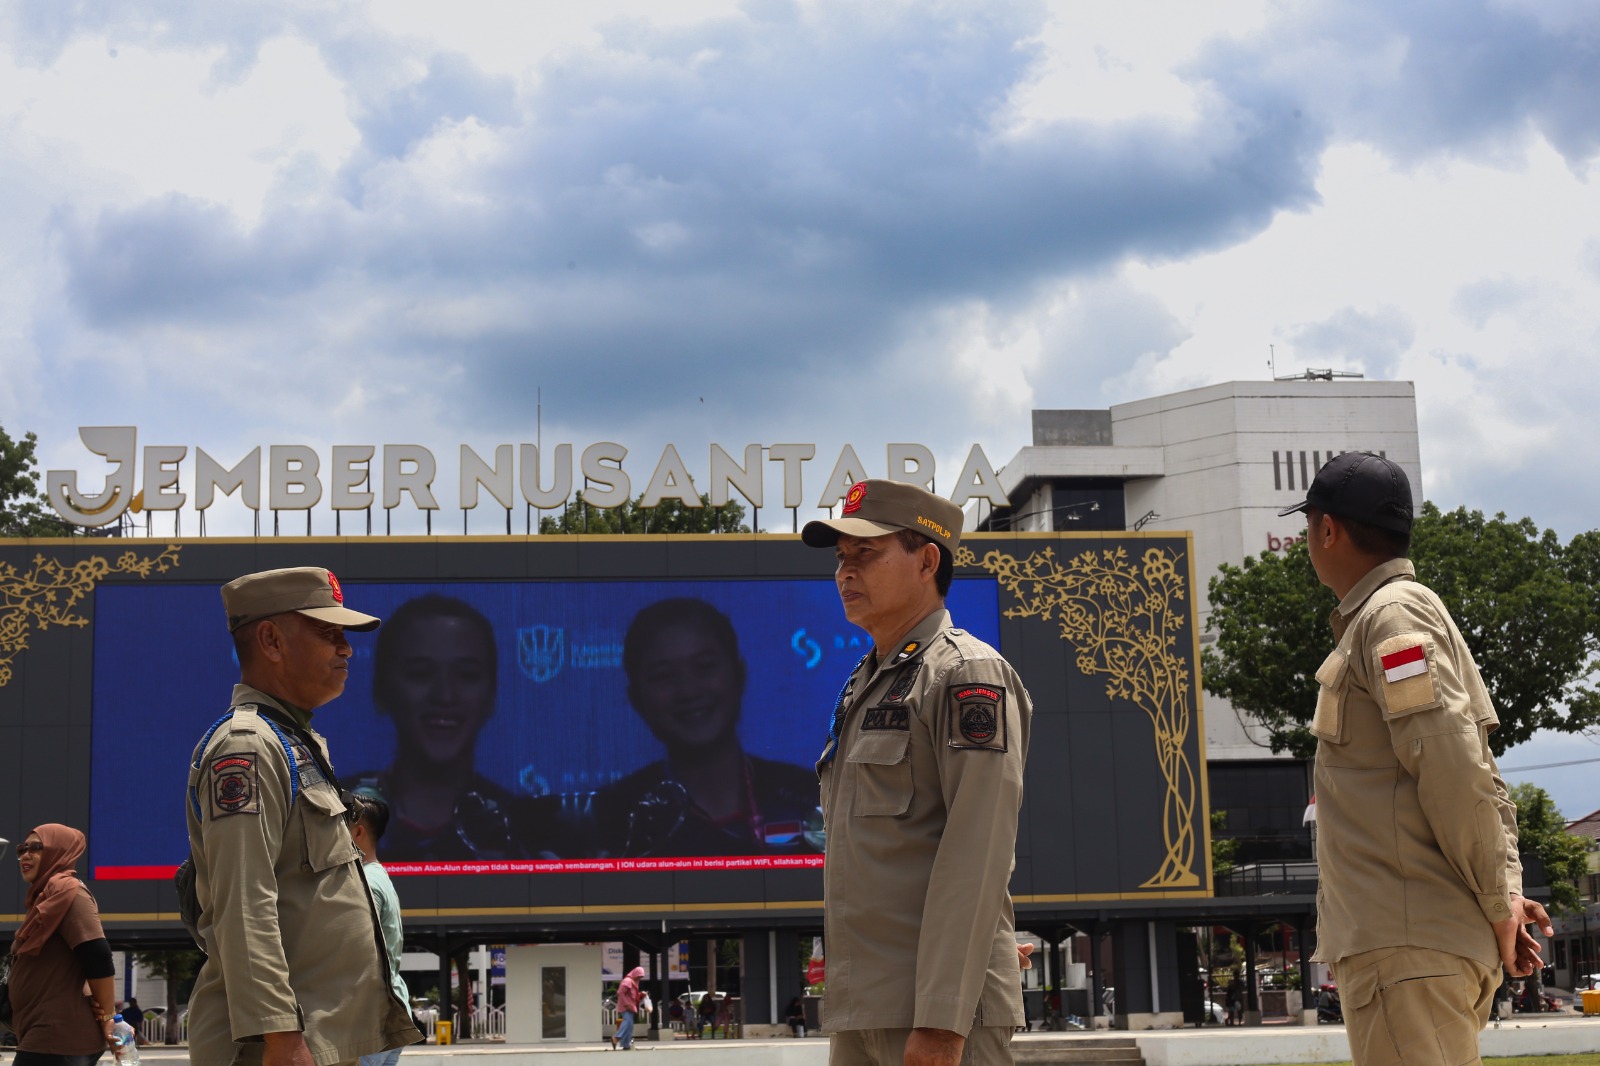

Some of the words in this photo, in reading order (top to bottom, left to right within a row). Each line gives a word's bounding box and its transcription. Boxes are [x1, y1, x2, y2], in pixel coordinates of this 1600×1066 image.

[46, 426, 440, 526] JEMBER
[460, 442, 1011, 509] NUSANTARA
[462, 864, 489, 872] dengan
[510, 863, 533, 871] buang
[535, 863, 562, 871] sampah
[565, 862, 615, 870] sembarangan.
[726, 859, 752, 867] partikel
[805, 858, 823, 866] login
